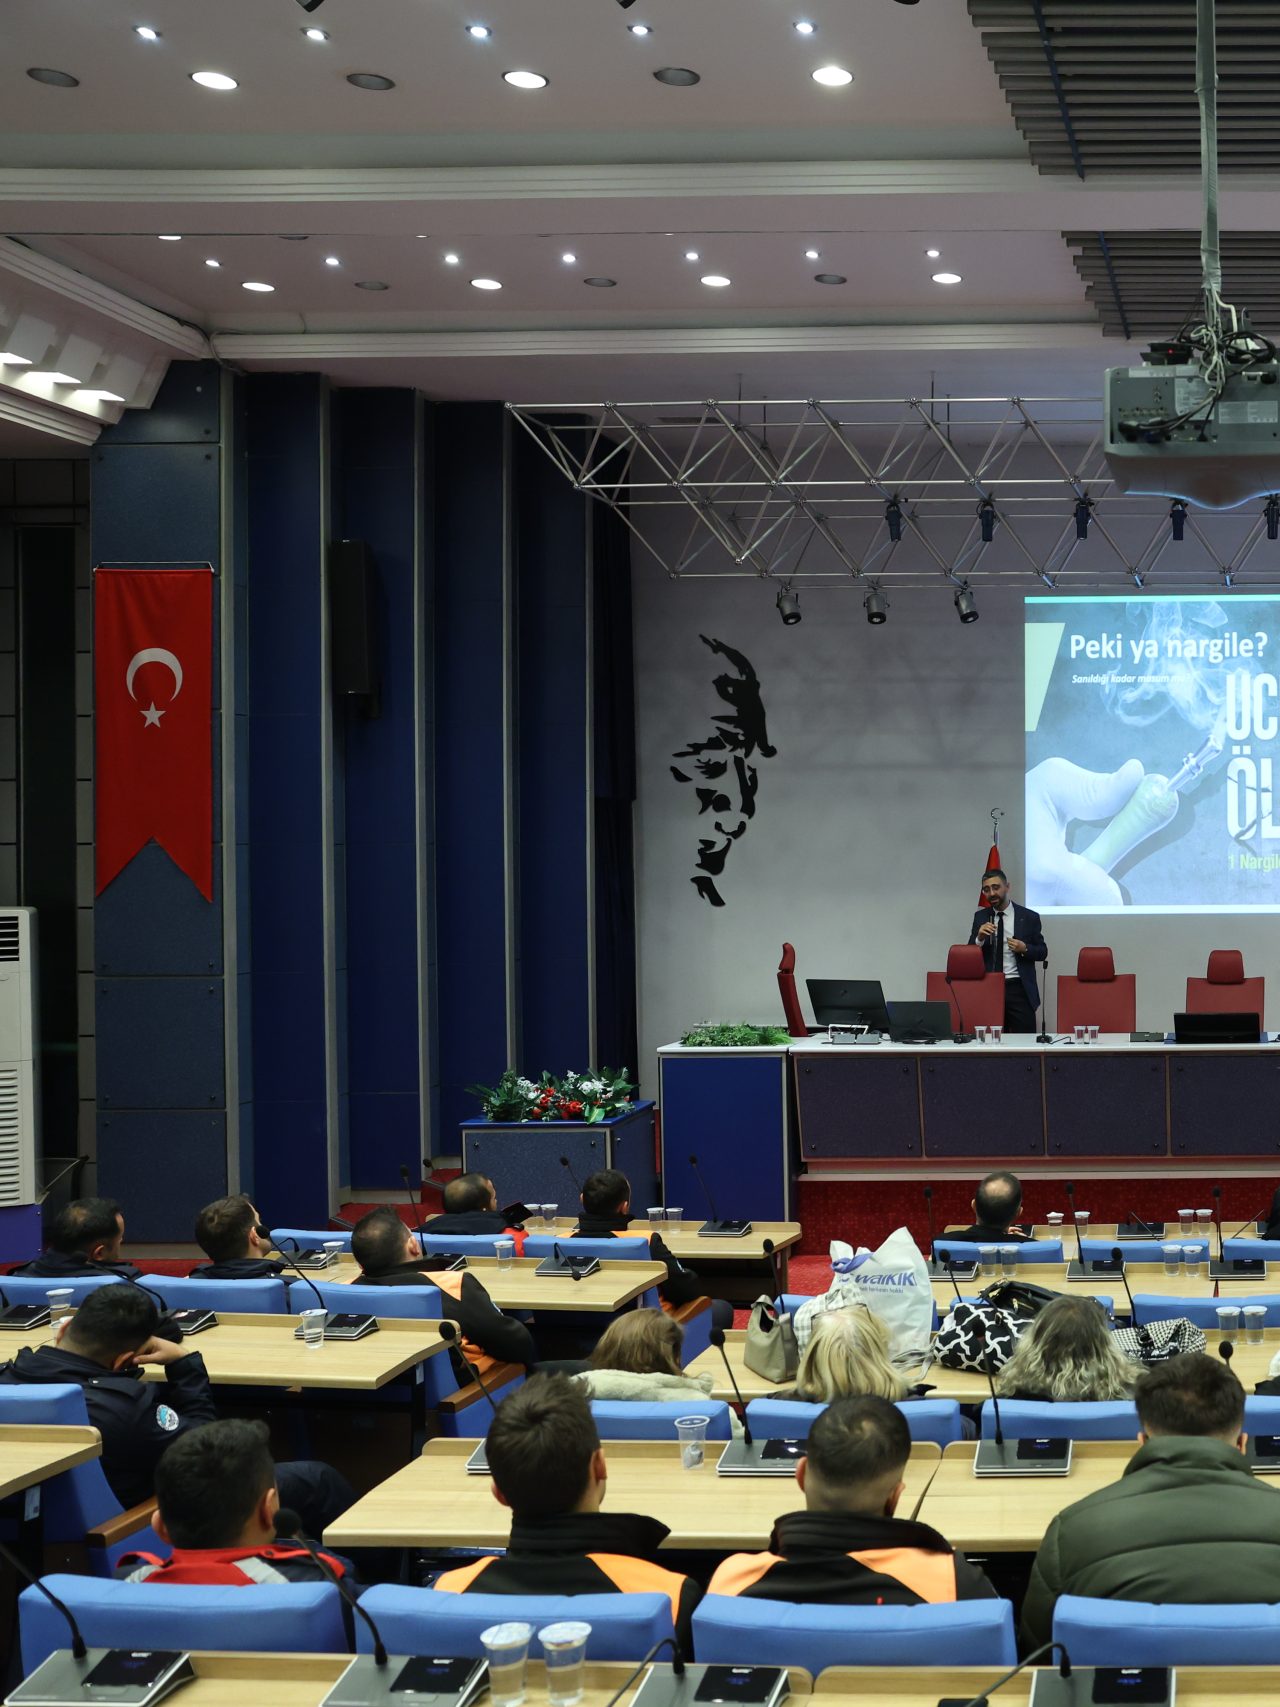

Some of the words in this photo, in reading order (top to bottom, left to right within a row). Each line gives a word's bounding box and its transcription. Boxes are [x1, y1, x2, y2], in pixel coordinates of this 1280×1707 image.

[1070, 632, 1122, 659] Peki
[1130, 638, 1159, 664] ya
[1167, 631, 1268, 664] nargile?
[1110, 673, 1136, 683] kadar
[1137, 674, 1170, 684] masum
[1228, 854, 1235, 869] 1
